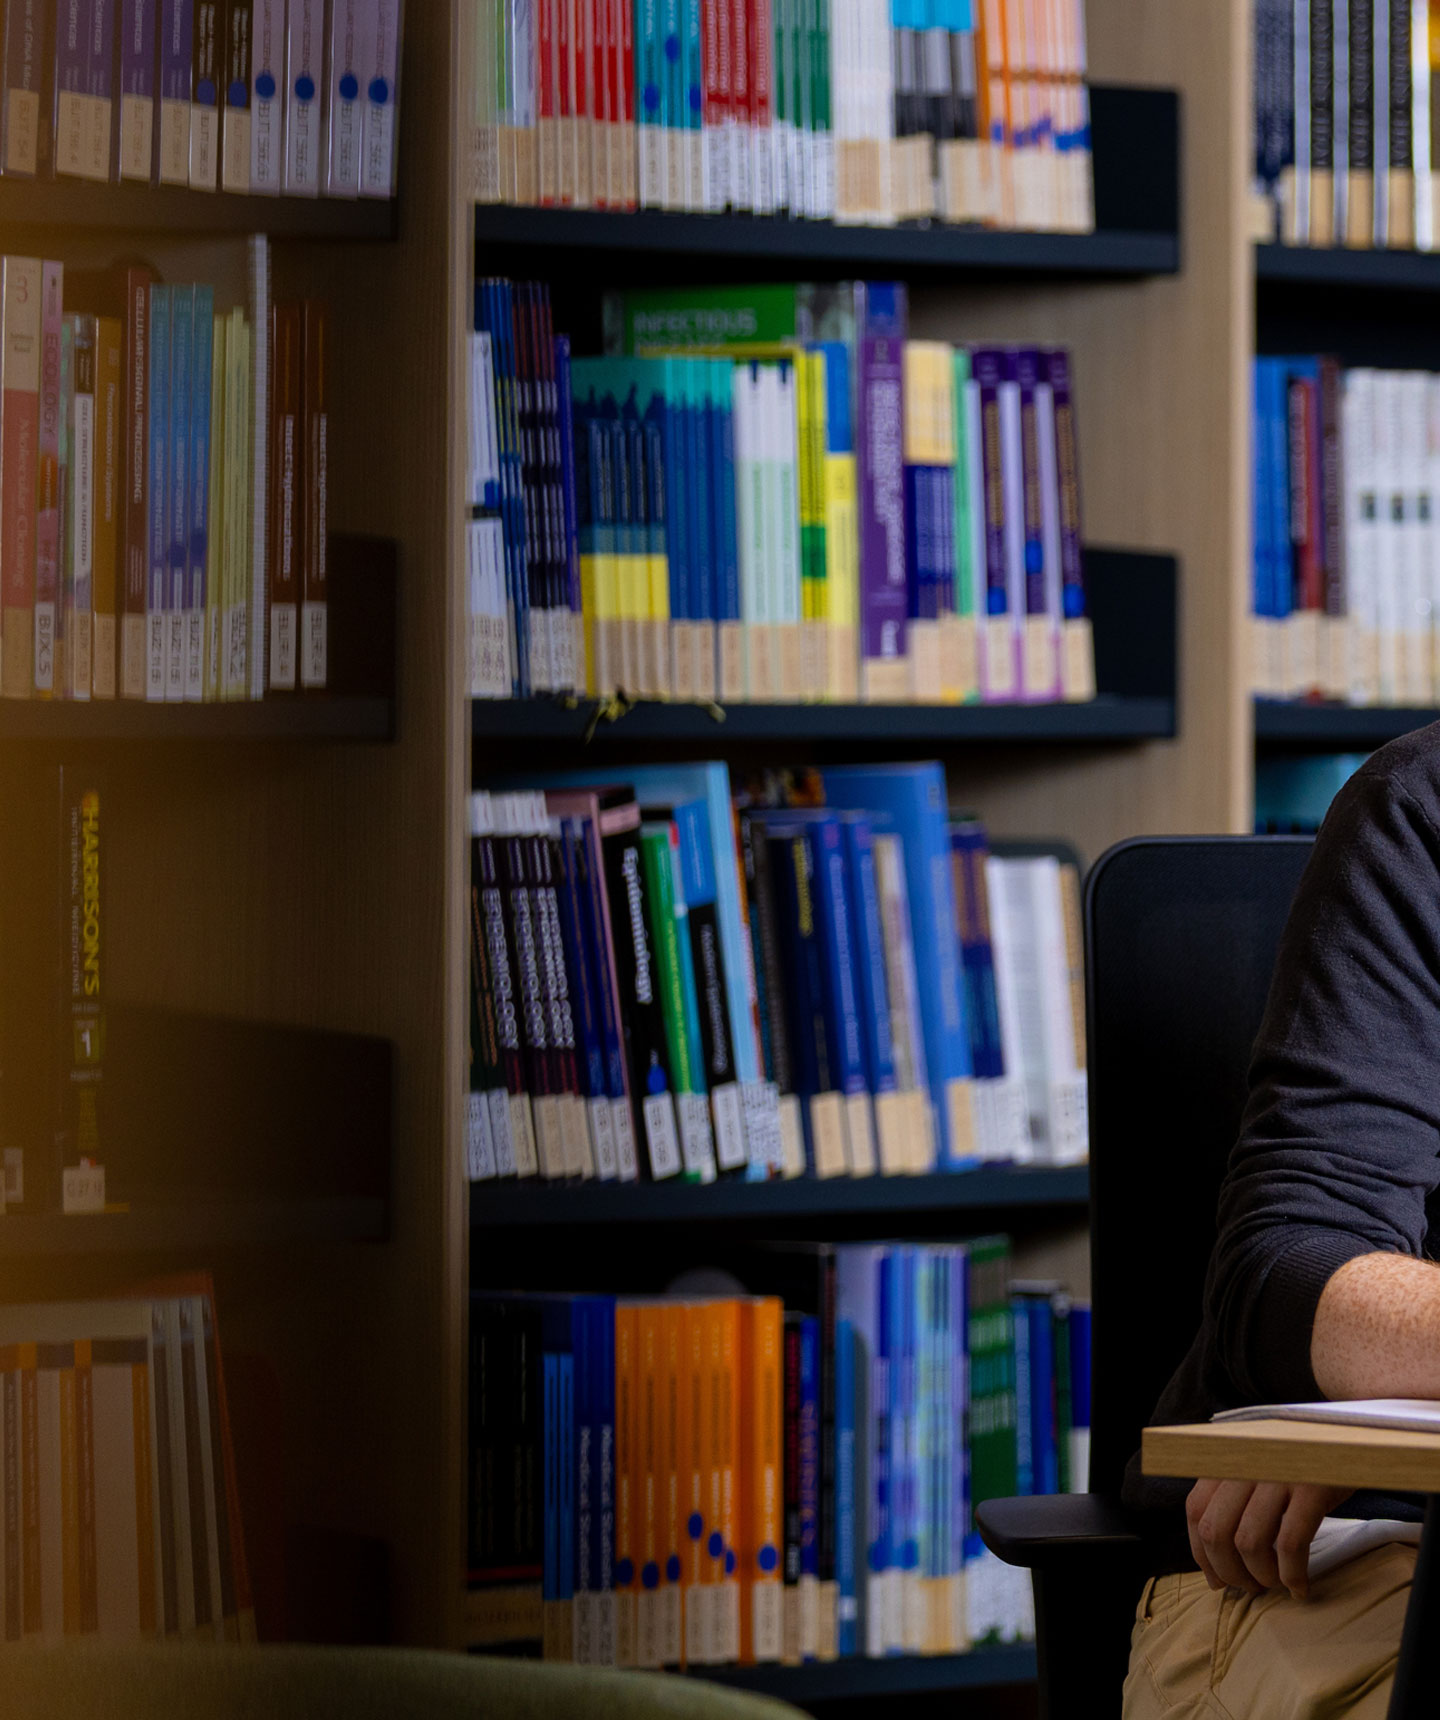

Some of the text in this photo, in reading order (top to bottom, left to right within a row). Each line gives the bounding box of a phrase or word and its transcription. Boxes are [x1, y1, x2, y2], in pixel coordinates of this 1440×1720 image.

[43, 332, 58, 437] ECOLOGY
[82, 807, 100, 997] HARRISON'S
[622, 847, 653, 1004] Epidemiology
